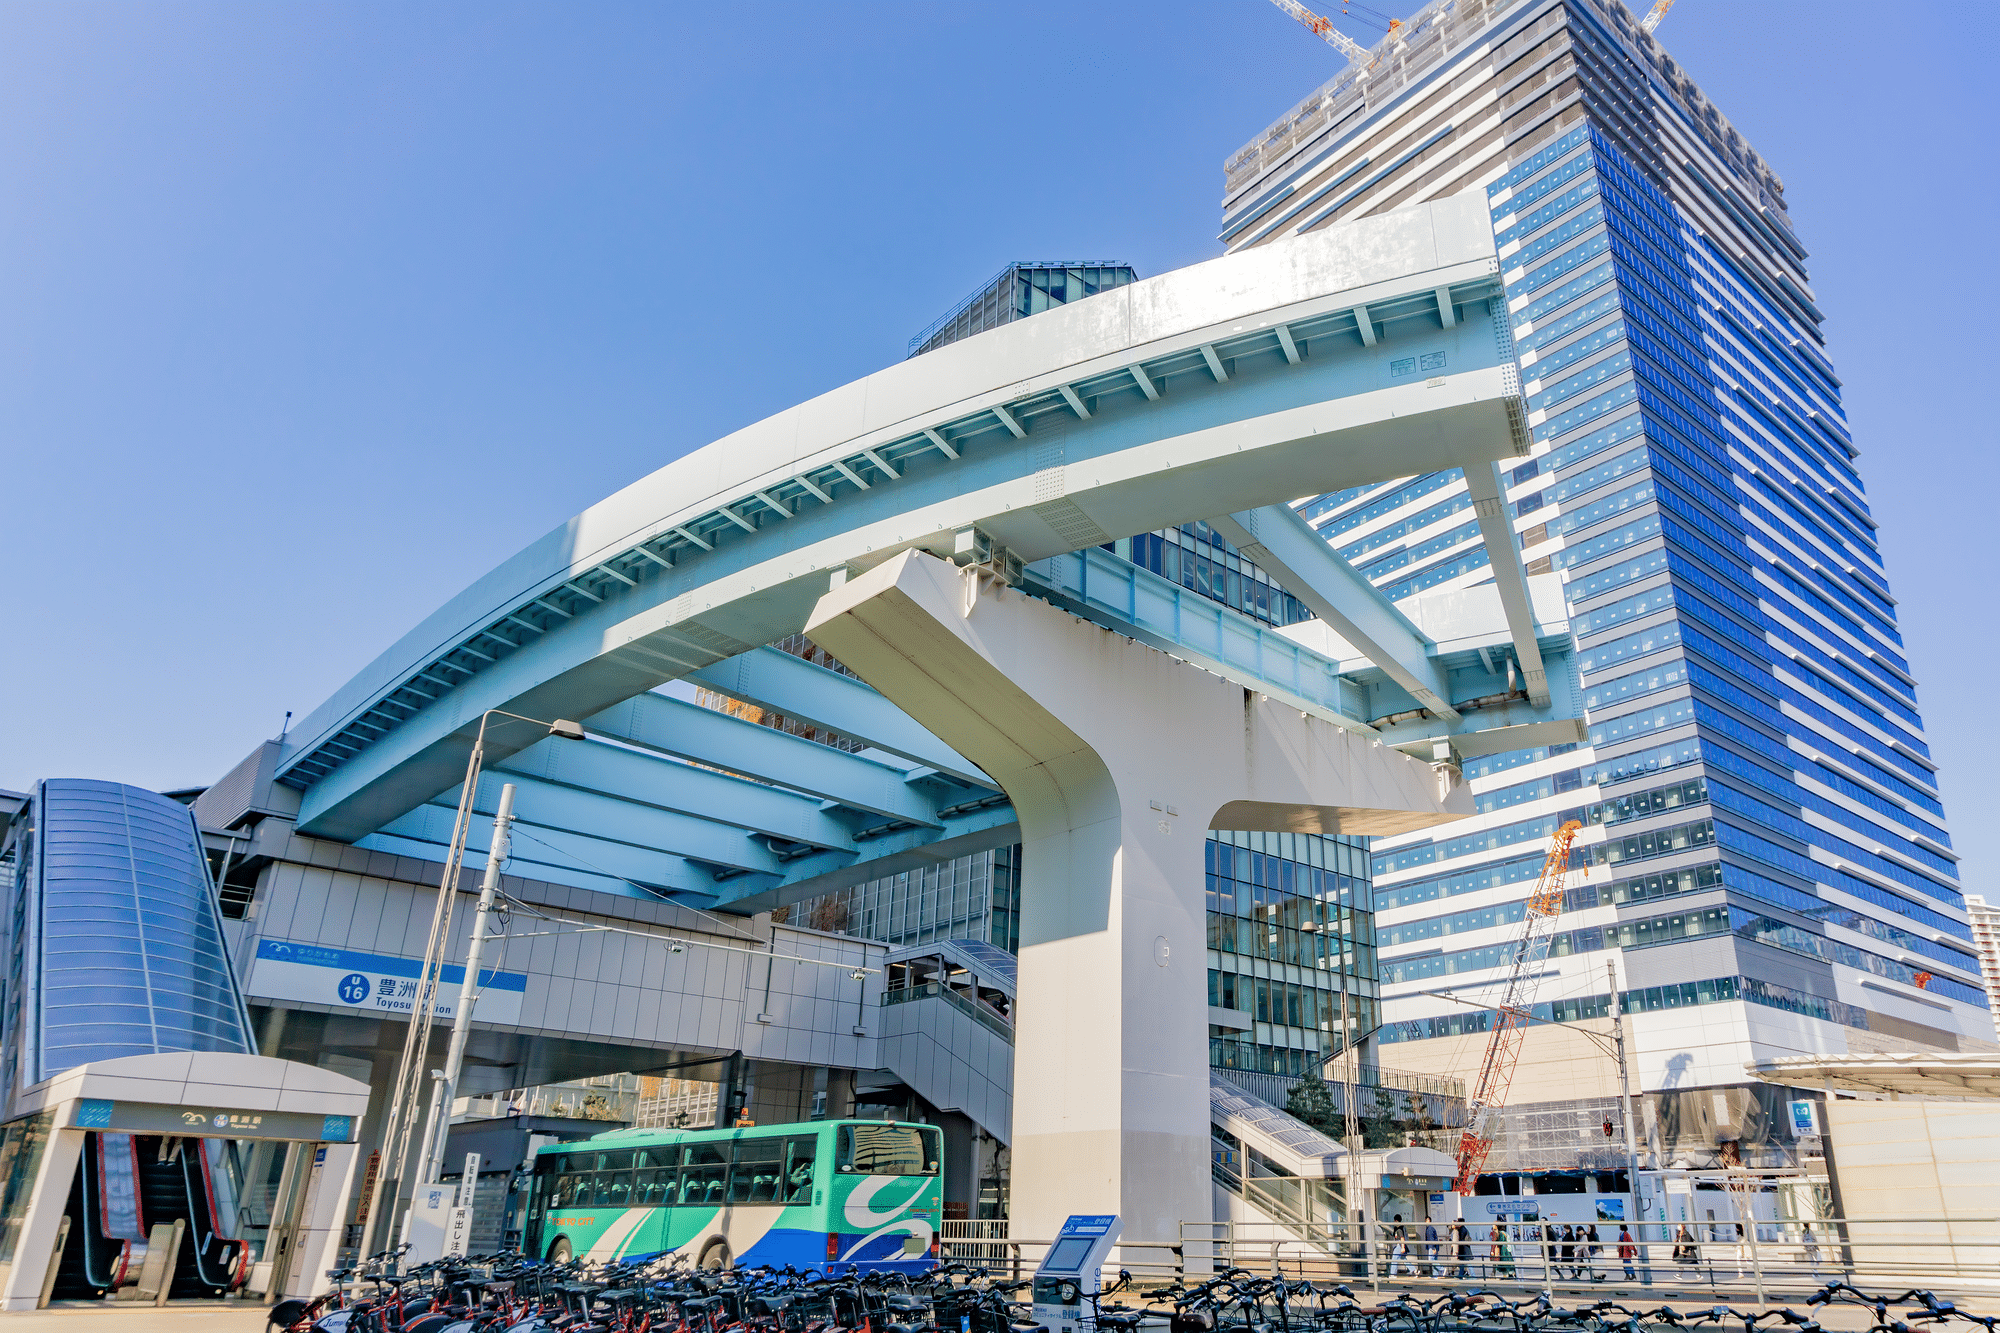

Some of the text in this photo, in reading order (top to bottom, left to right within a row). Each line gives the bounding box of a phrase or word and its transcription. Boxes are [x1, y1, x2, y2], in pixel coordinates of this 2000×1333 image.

[351, 976, 361, 985] U
[344, 985, 363, 1000] 16
[376, 996, 412, 1009] Toyosu
